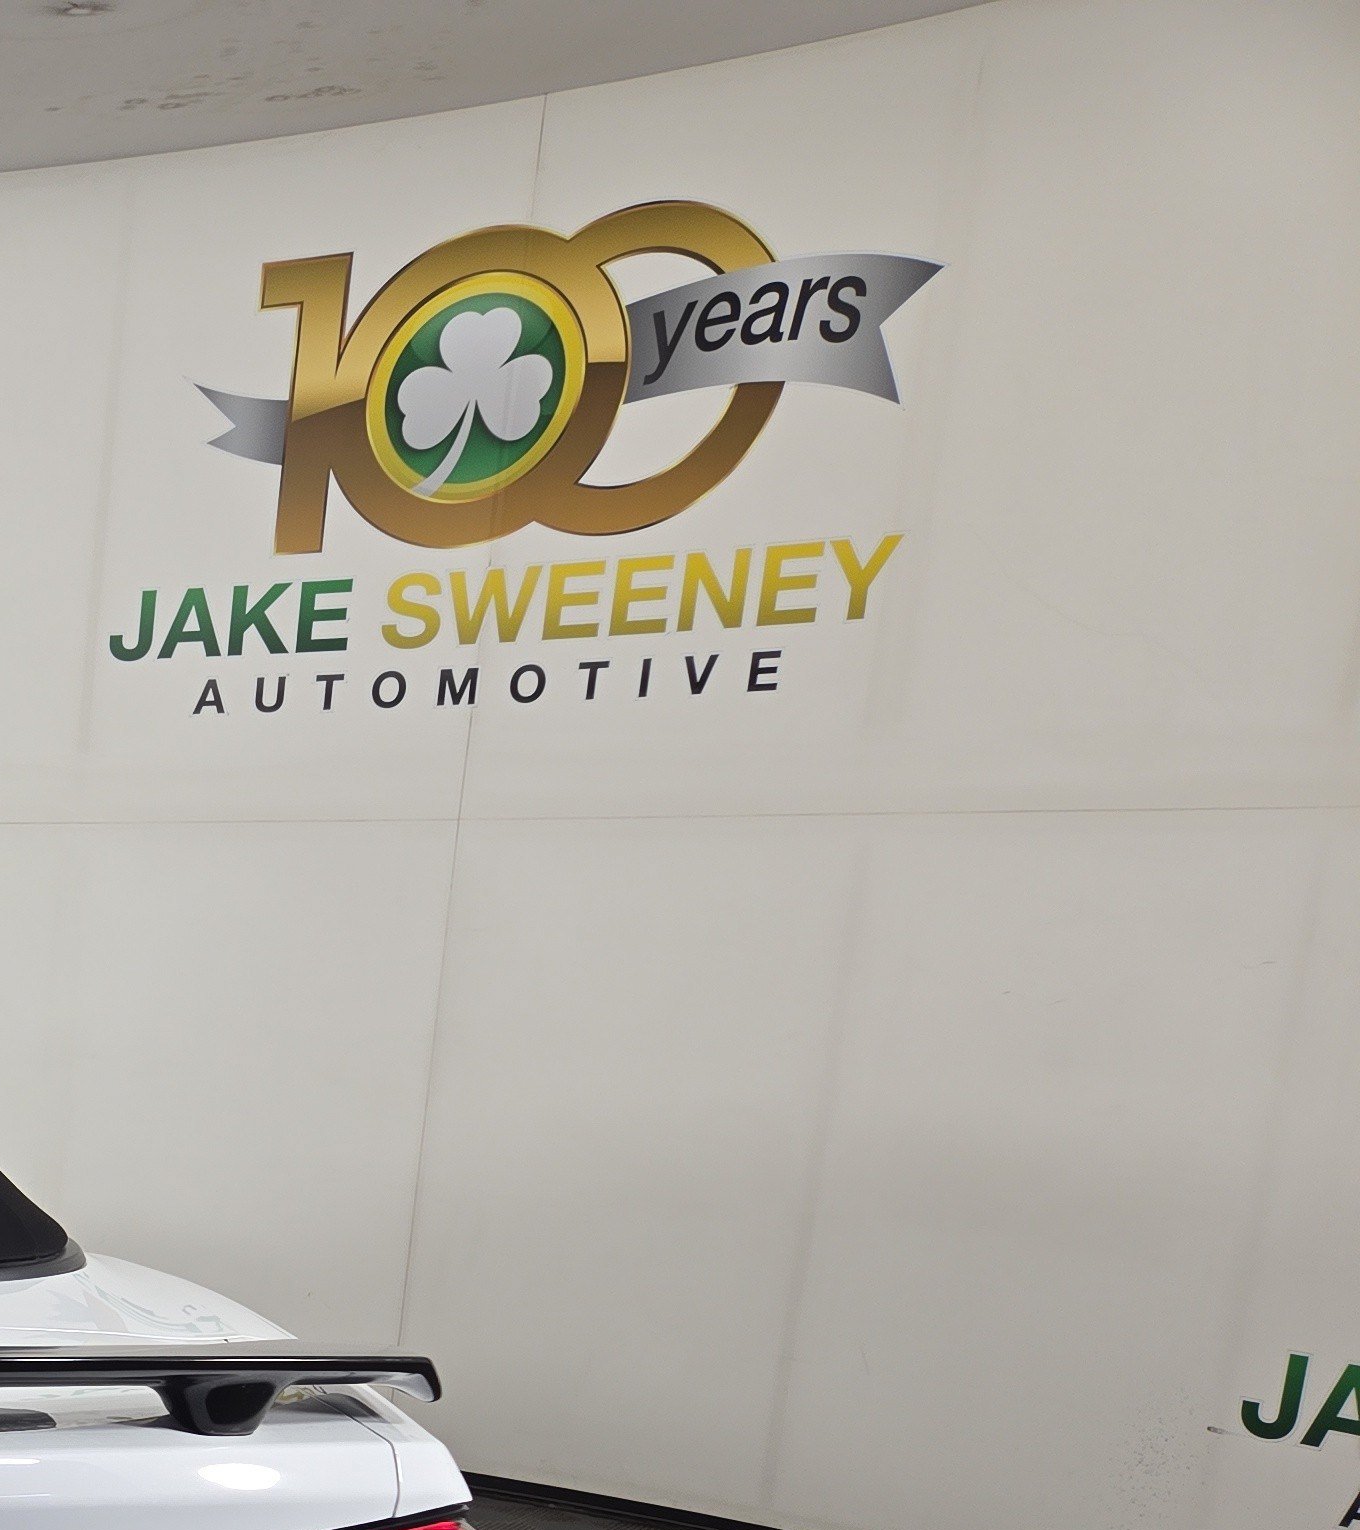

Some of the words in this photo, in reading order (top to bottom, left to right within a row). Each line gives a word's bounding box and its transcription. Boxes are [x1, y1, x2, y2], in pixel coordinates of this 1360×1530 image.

[643, 274, 867, 386] years
[109, 578, 354, 662] JAKE
[380, 533, 904, 651] SWEENEY
[192, 650, 783, 716] AUTOMOTIVE
